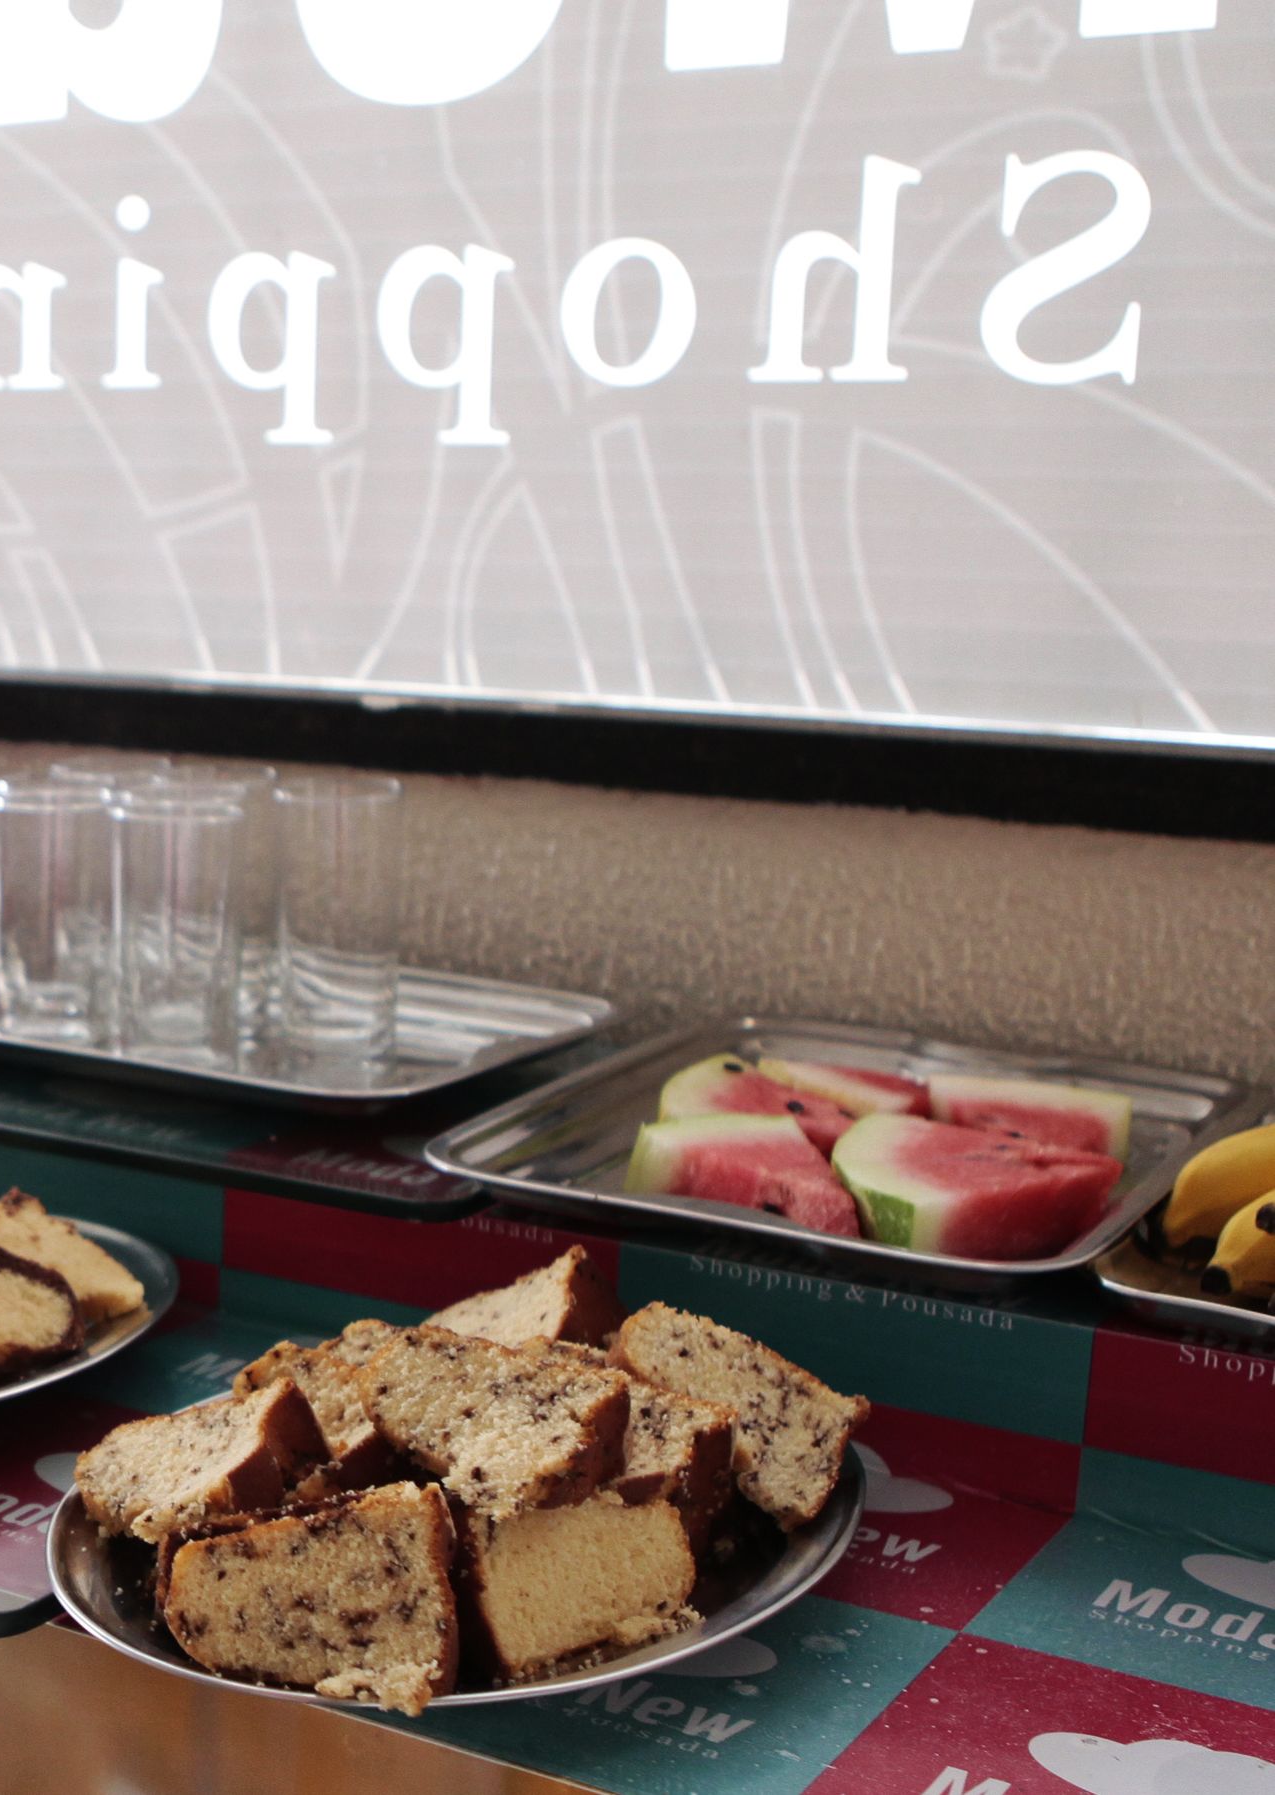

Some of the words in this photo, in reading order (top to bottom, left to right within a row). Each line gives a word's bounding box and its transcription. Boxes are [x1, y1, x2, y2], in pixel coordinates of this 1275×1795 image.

[460, 1216, 554, 1243] ousada
[690, 1254, 832, 1300] Shopping
[845, 1283, 866, 1303] &
[881, 1288, 1014, 1331] Pousada
[1179, 1344, 1275, 1387] Shop
[1088, 1608, 1271, 1663] Shopping
[575, 1679, 756, 1744] New
